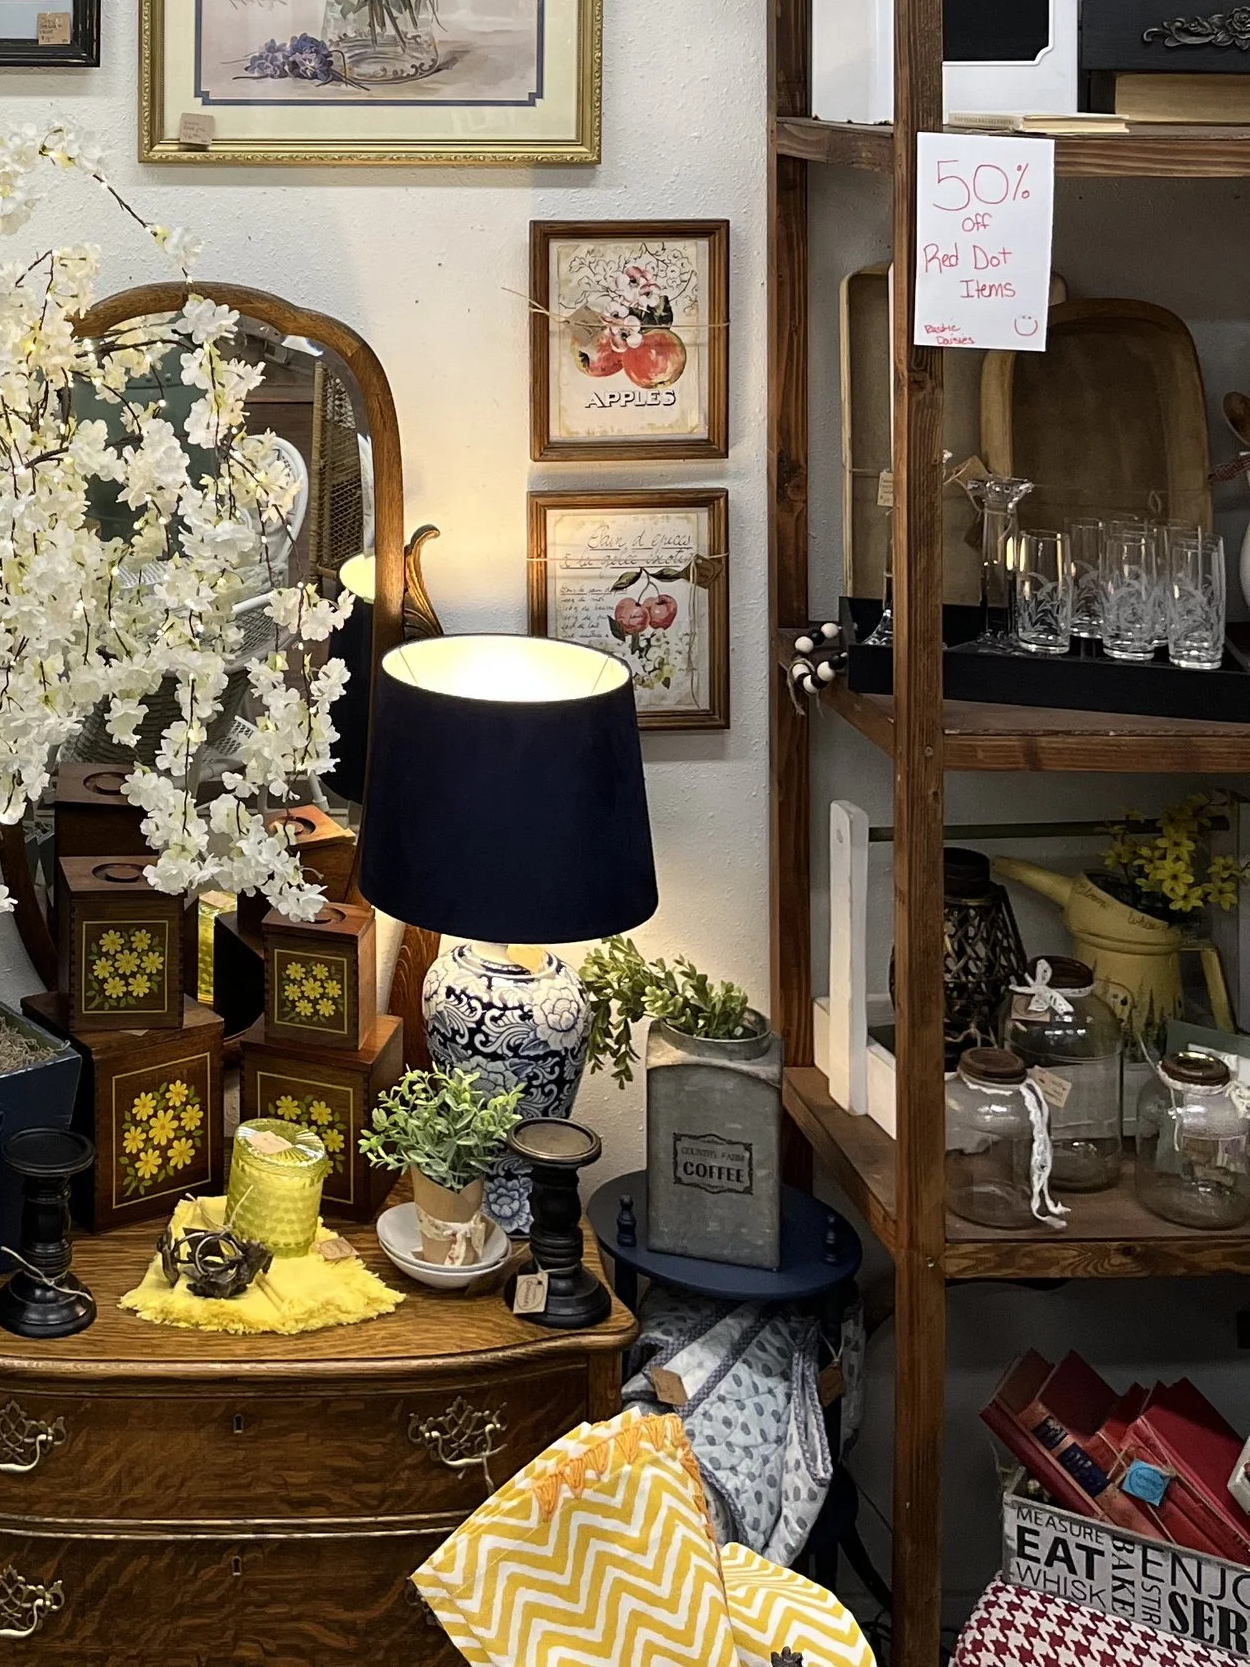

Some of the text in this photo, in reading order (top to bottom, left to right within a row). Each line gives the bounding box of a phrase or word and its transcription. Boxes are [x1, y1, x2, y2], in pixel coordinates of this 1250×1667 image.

[932, 159, 1030, 211] 50%
[923, 242, 1013, 274] Red Dot
[960, 279, 1016, 299] Items
[584, 390, 677, 409] APPLES
[682, 1161, 745, 1184] COFFEE
[1016, 1507, 1104, 1546] MEASURE
[1016, 1524, 1105, 1581] EAT
[1016, 1561, 1107, 1609] WHISK
[1111, 1535, 1136, 1618] BAKE
[1141, 1580, 1162, 1626] STIR
